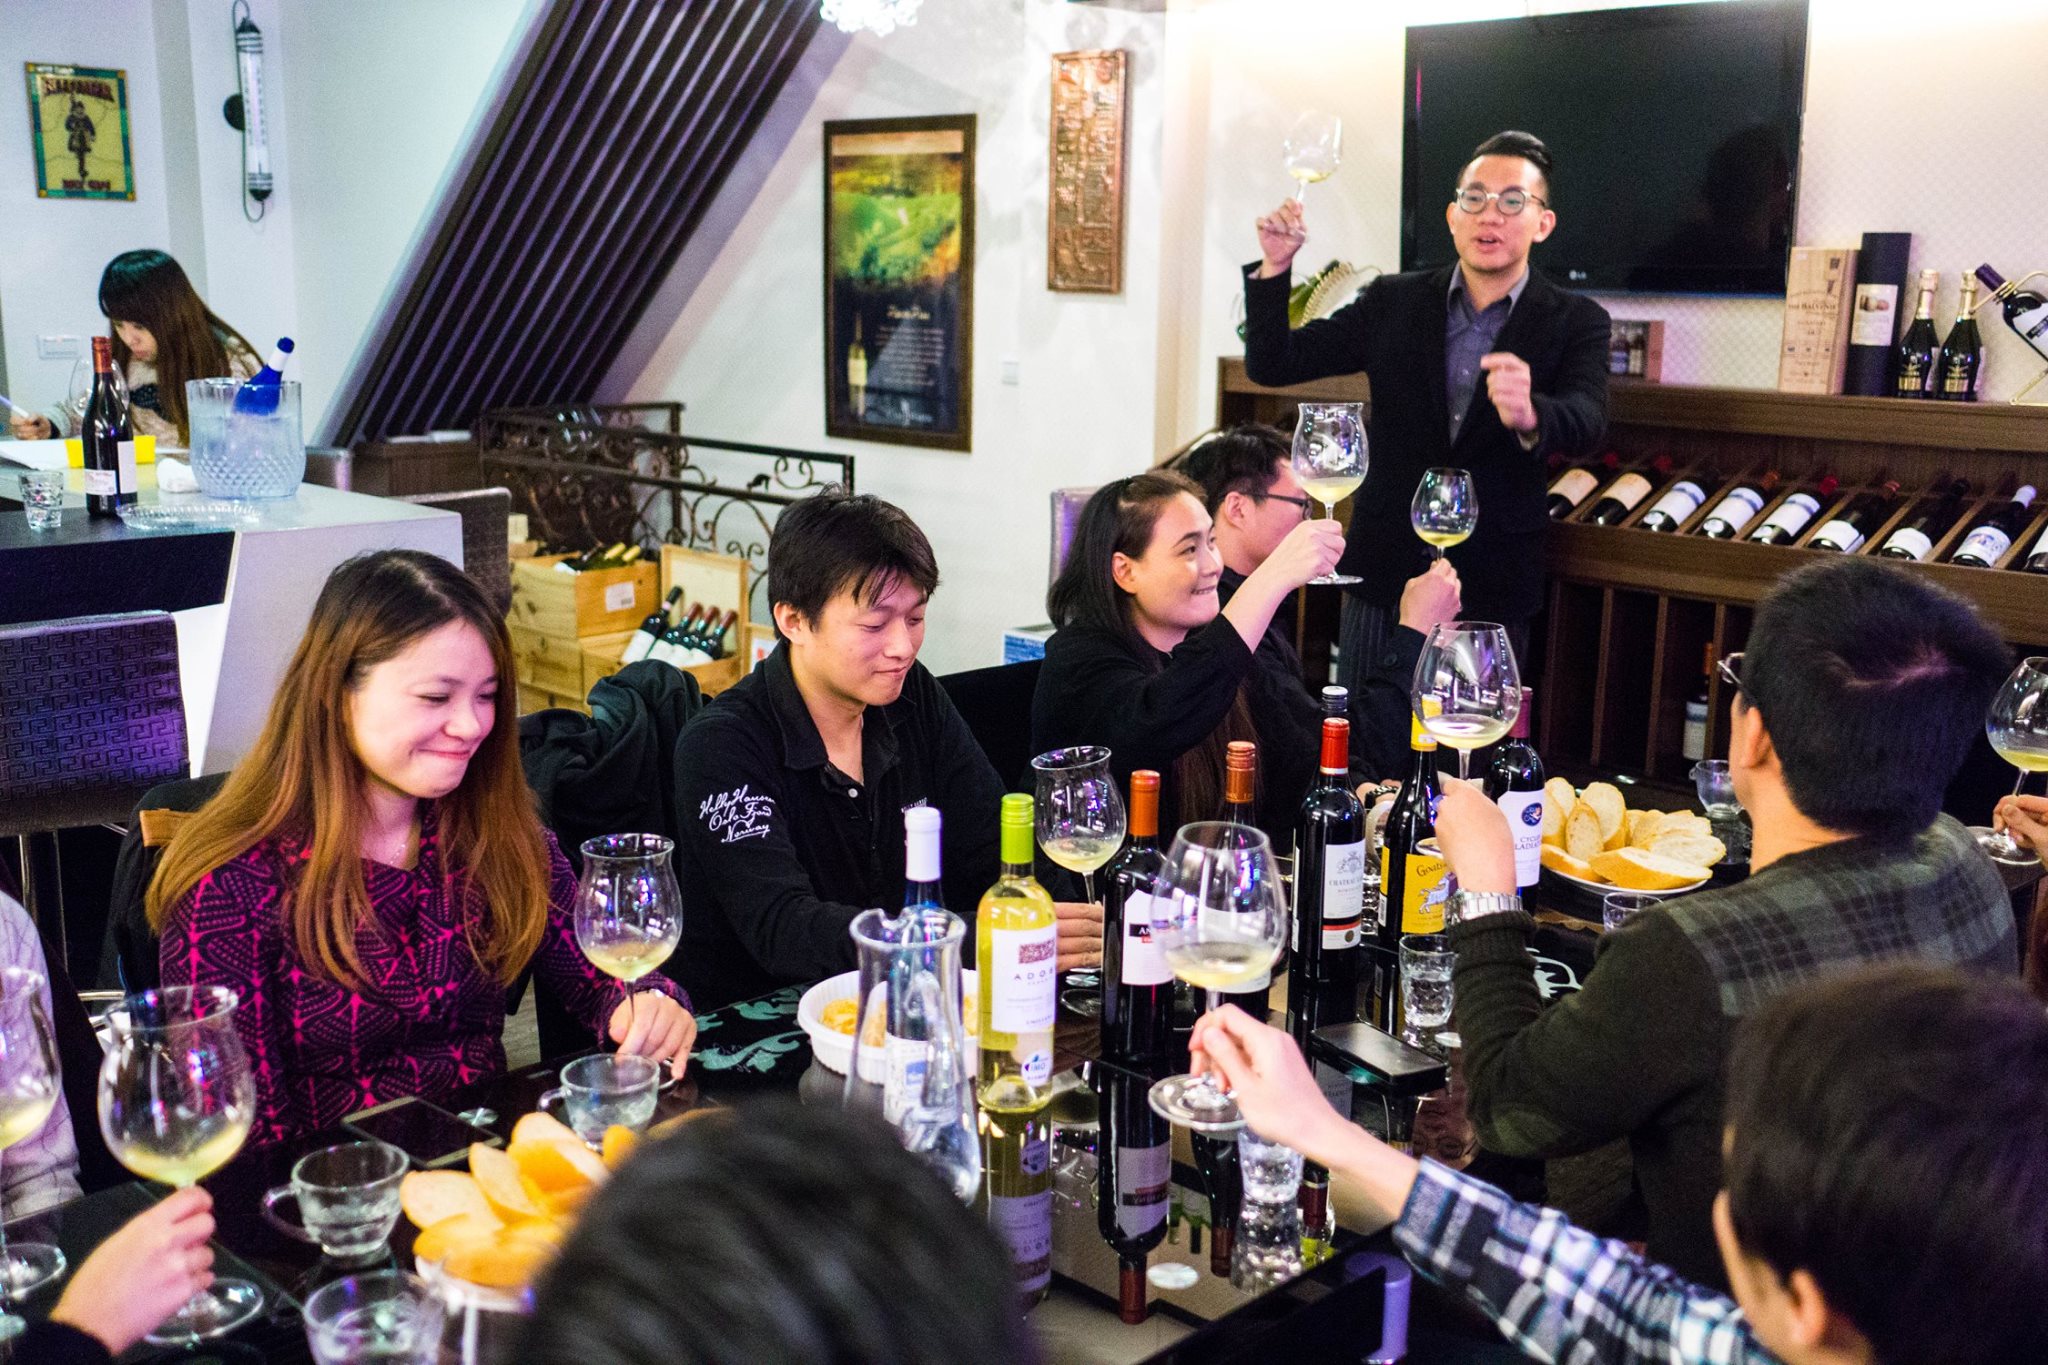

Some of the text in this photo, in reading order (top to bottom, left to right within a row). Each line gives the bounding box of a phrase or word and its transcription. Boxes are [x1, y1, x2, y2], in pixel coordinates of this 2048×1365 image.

[699, 784, 776, 819] Helly Hansen
[709, 806, 740, 831] Oslo
[721, 819, 770, 843] Norway
